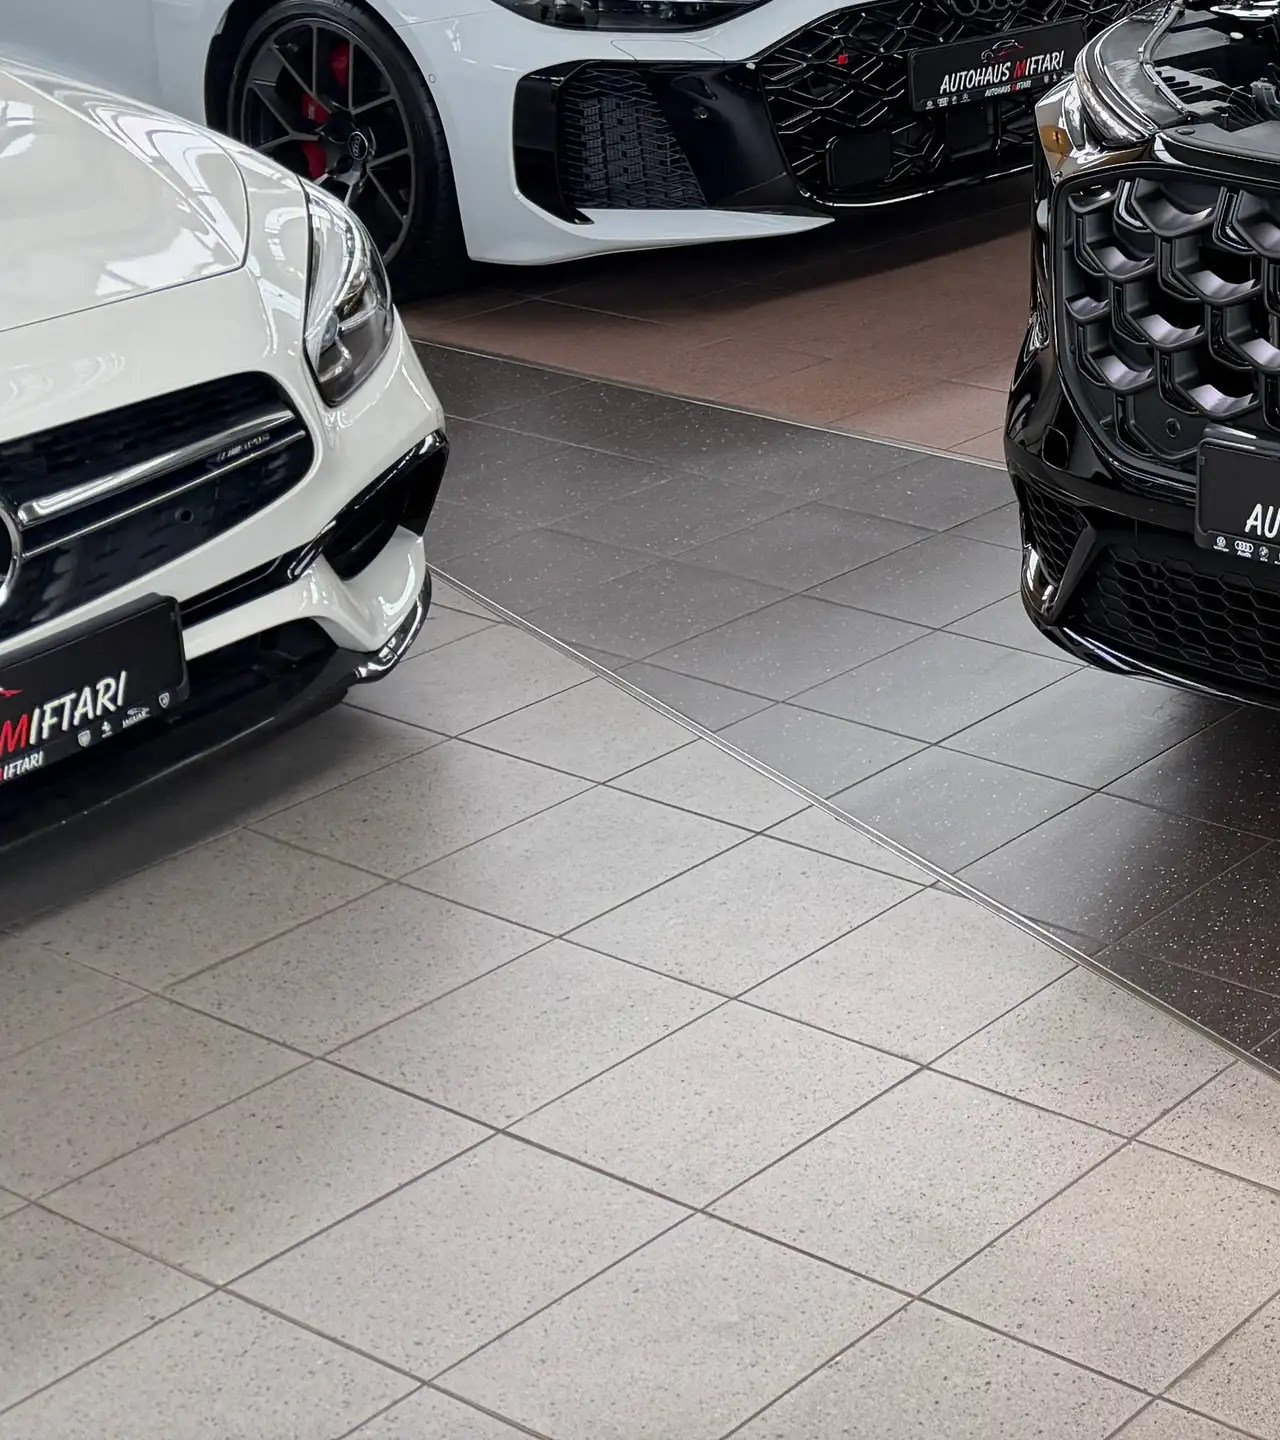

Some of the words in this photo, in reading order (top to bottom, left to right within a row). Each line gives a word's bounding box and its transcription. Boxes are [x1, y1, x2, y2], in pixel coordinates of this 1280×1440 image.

[939, 61, 1010, 95] AUTOHAUS
[1013, 51, 1065, 78] MIFTARI
[0, 670, 127, 757] MIFTARI
